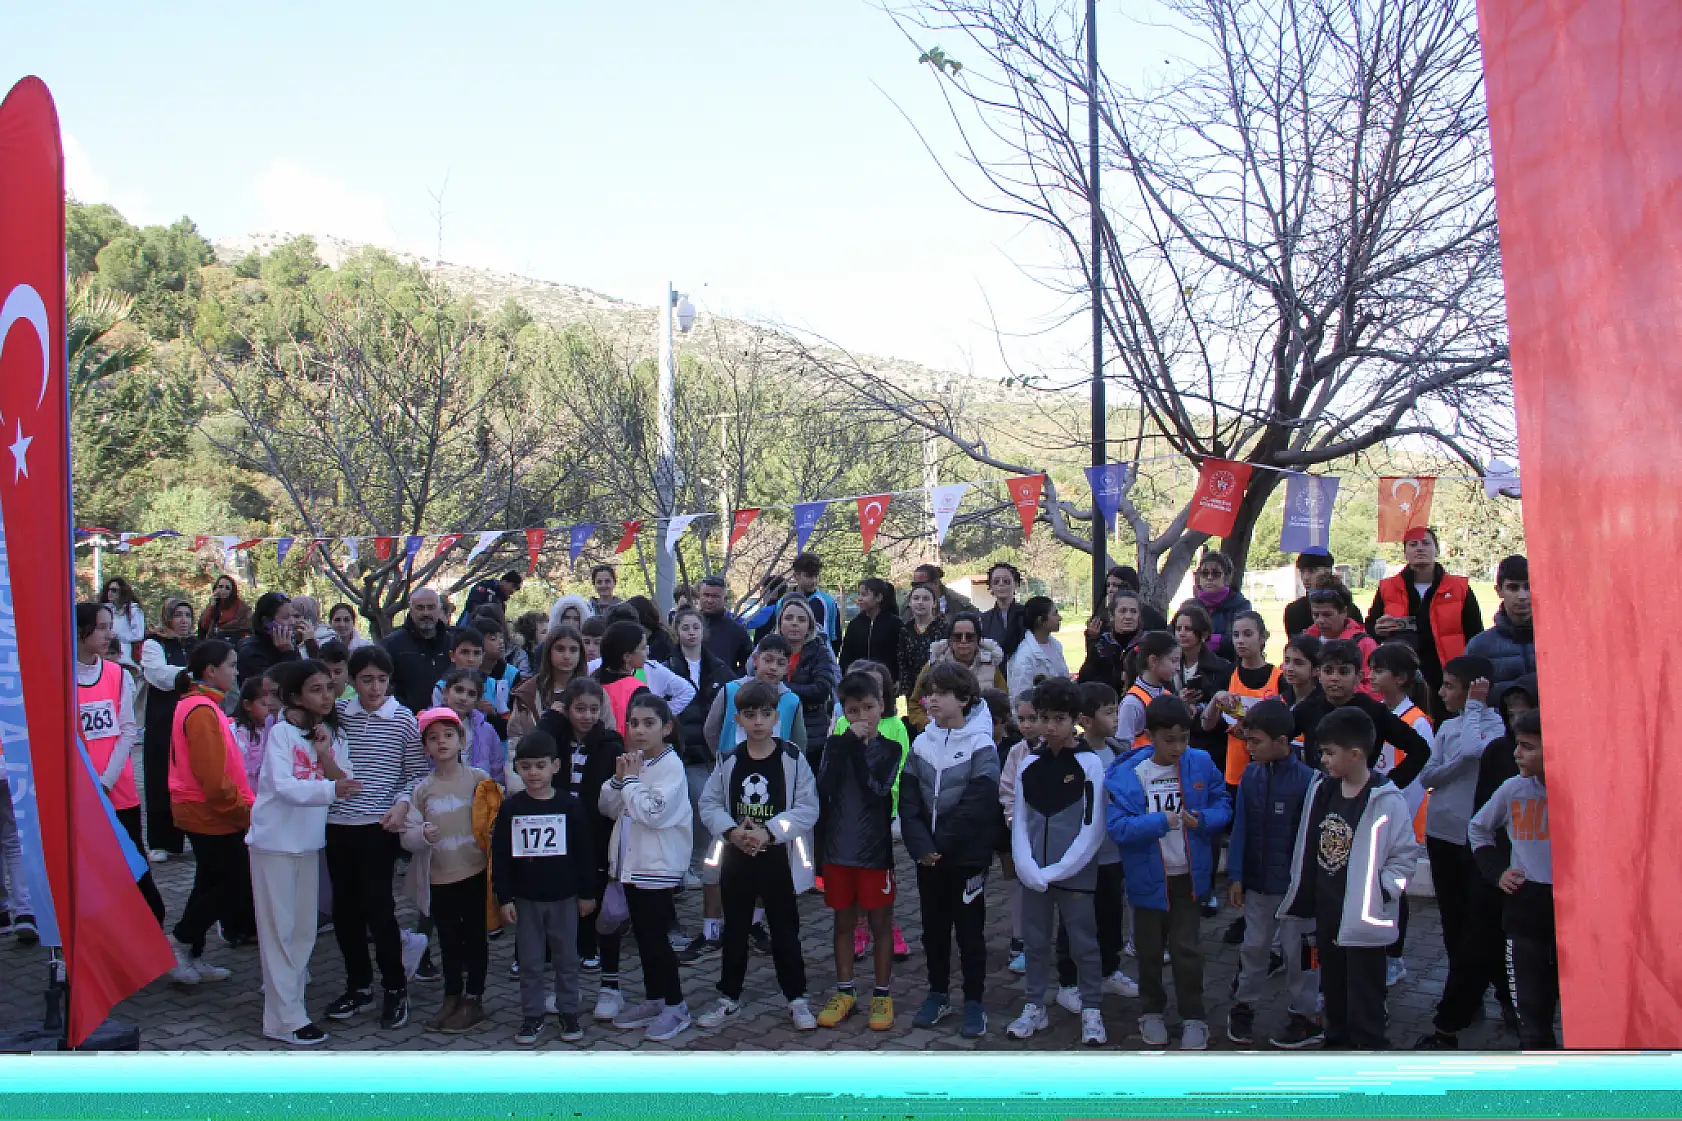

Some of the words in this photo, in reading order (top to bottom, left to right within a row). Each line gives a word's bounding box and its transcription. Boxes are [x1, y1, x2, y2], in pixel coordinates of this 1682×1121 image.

[81, 709, 113, 731] 263
[1153, 792, 1182, 814] 147
[520, 826, 557, 849] 172
